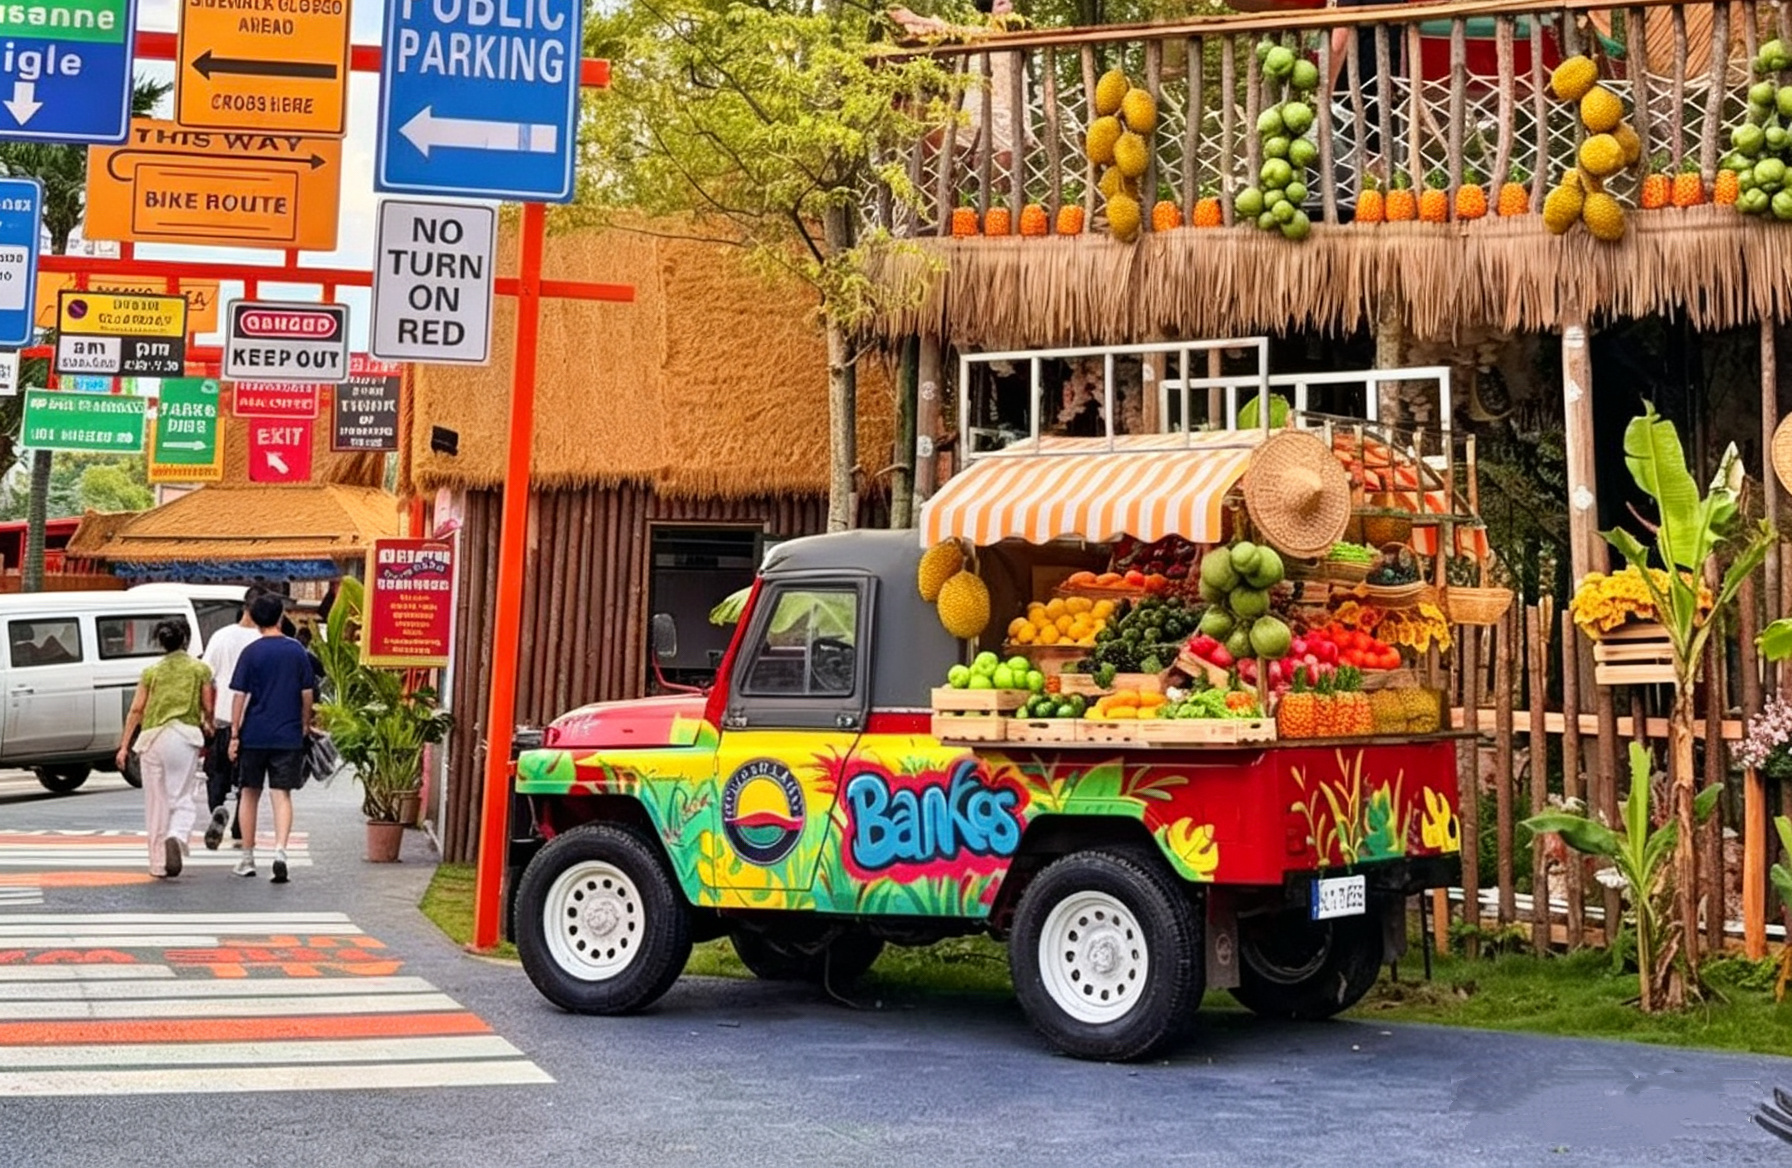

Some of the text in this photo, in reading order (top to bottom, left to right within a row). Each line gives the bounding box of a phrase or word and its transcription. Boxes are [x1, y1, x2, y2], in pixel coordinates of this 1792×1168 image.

[398, 28, 564, 84] PARKING
[135, 127, 303, 152] THIS WAY
[145, 190, 287, 214] BIKE ROUTE
[412, 217, 464, 244] NO
[387, 249, 482, 279] TURN
[408, 284, 460, 312] ON
[398, 318, 465, 346] RED
[232, 348, 291, 367] KEEP
[257, 427, 304, 446] EXIT
